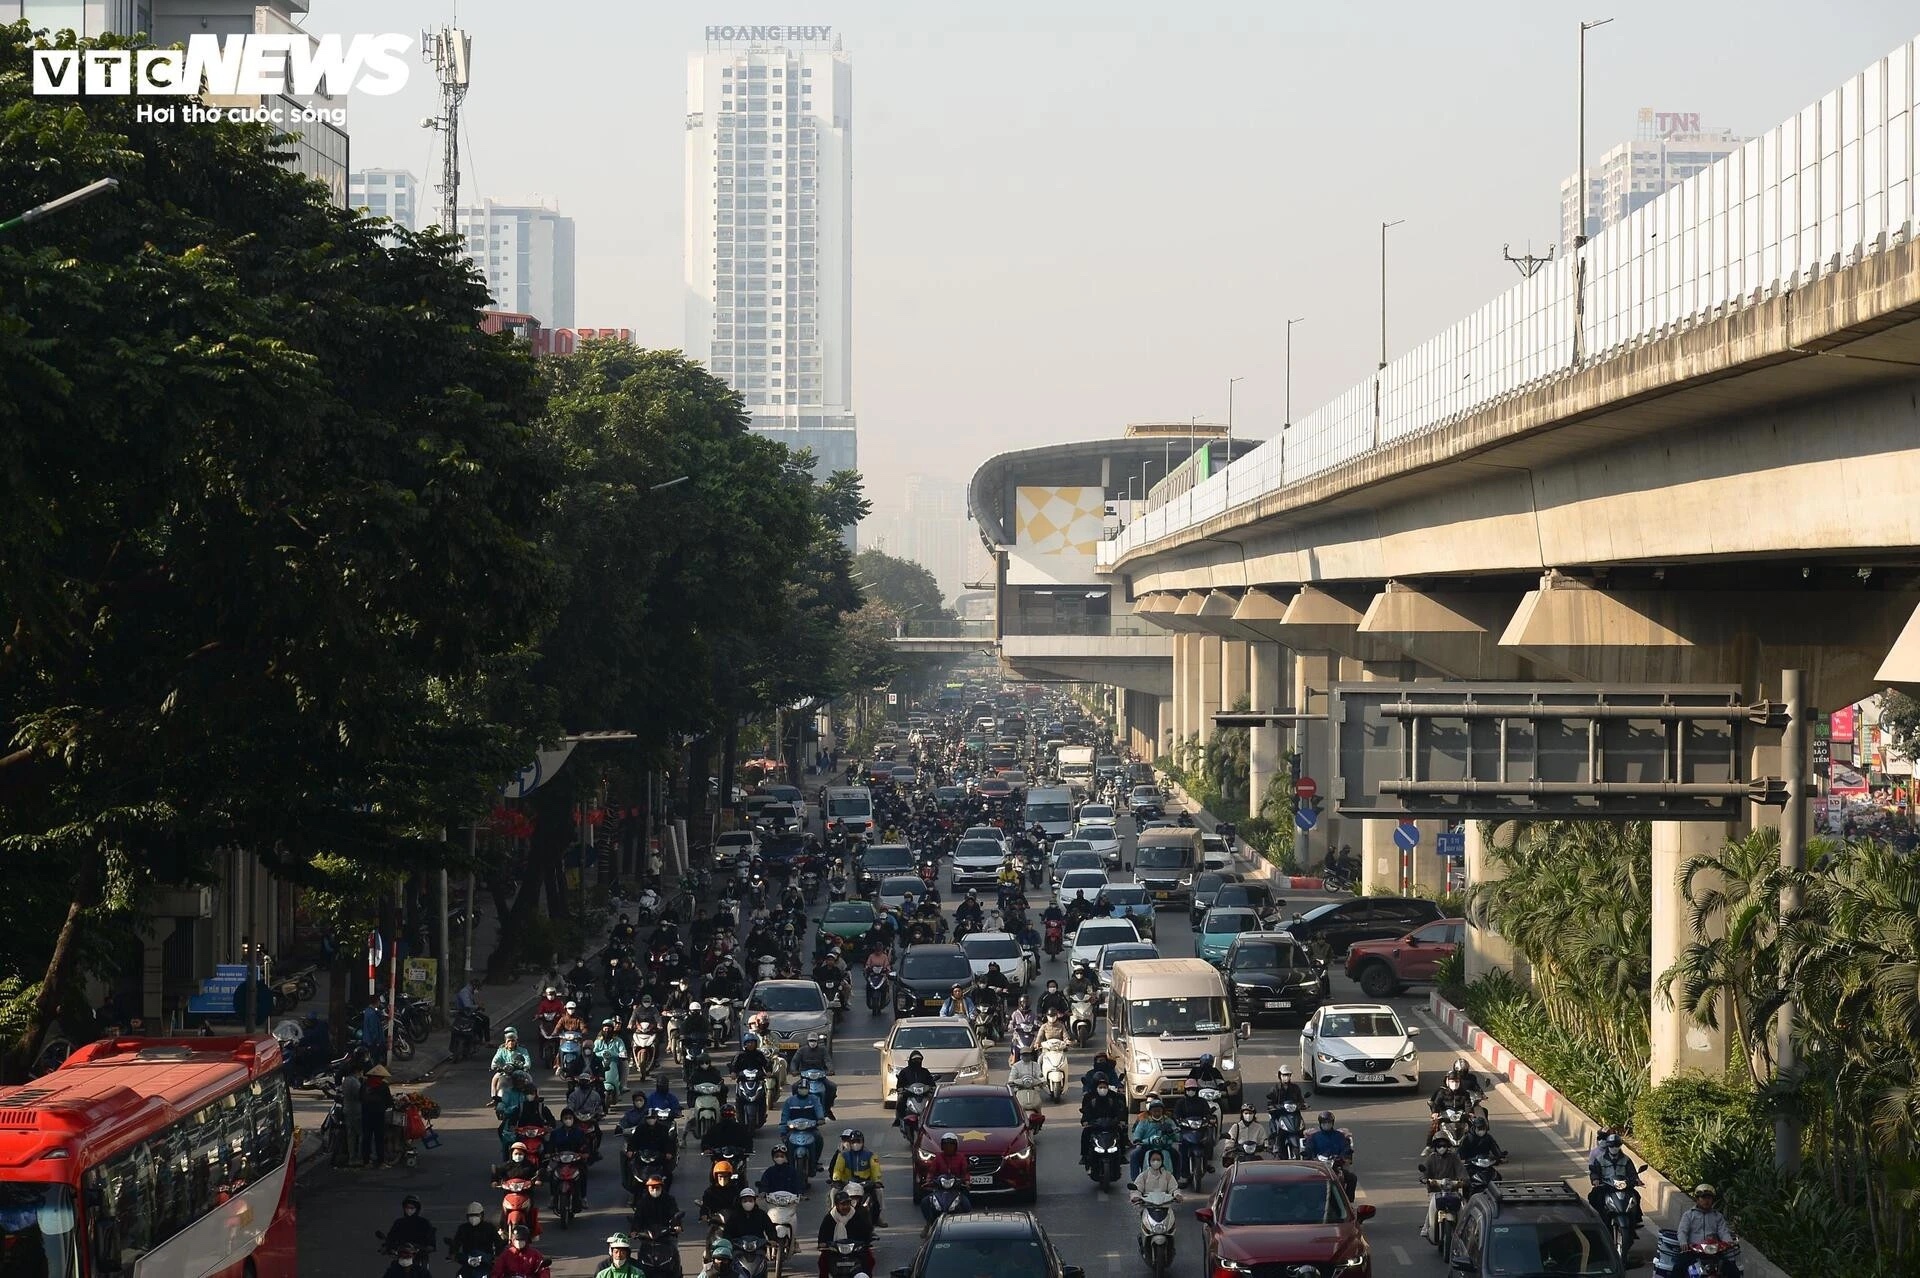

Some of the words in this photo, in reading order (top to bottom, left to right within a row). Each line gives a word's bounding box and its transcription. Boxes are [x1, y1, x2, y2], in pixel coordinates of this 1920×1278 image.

[705, 25, 781, 41] HOANG
[787, 25, 832, 41] HUY
[1655, 112, 1701, 132] TNR
